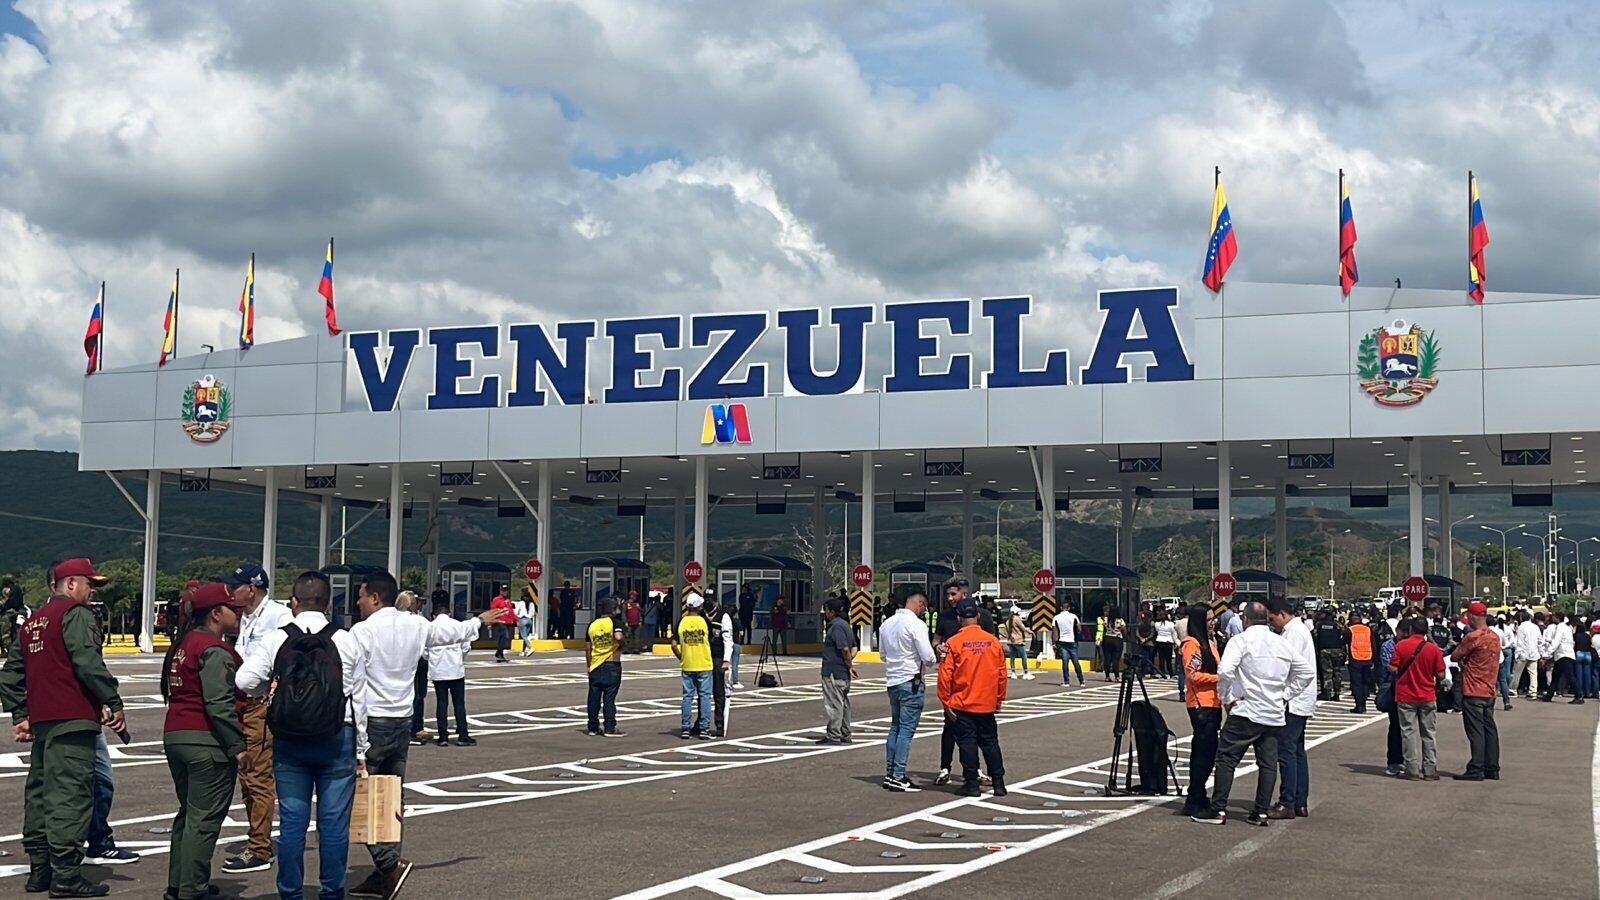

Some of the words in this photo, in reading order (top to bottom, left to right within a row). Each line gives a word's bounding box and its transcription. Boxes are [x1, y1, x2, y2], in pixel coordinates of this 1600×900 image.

[346, 286, 1195, 413] VENEZUELA
[526, 566, 541, 574] PARE
[685, 568, 701, 576] PARE
[854, 572, 871, 580] PARE
[1035, 577, 1053, 585] PARE
[1214, 581, 1233, 590] PARE
[1405, 585, 1426, 594] PARE
